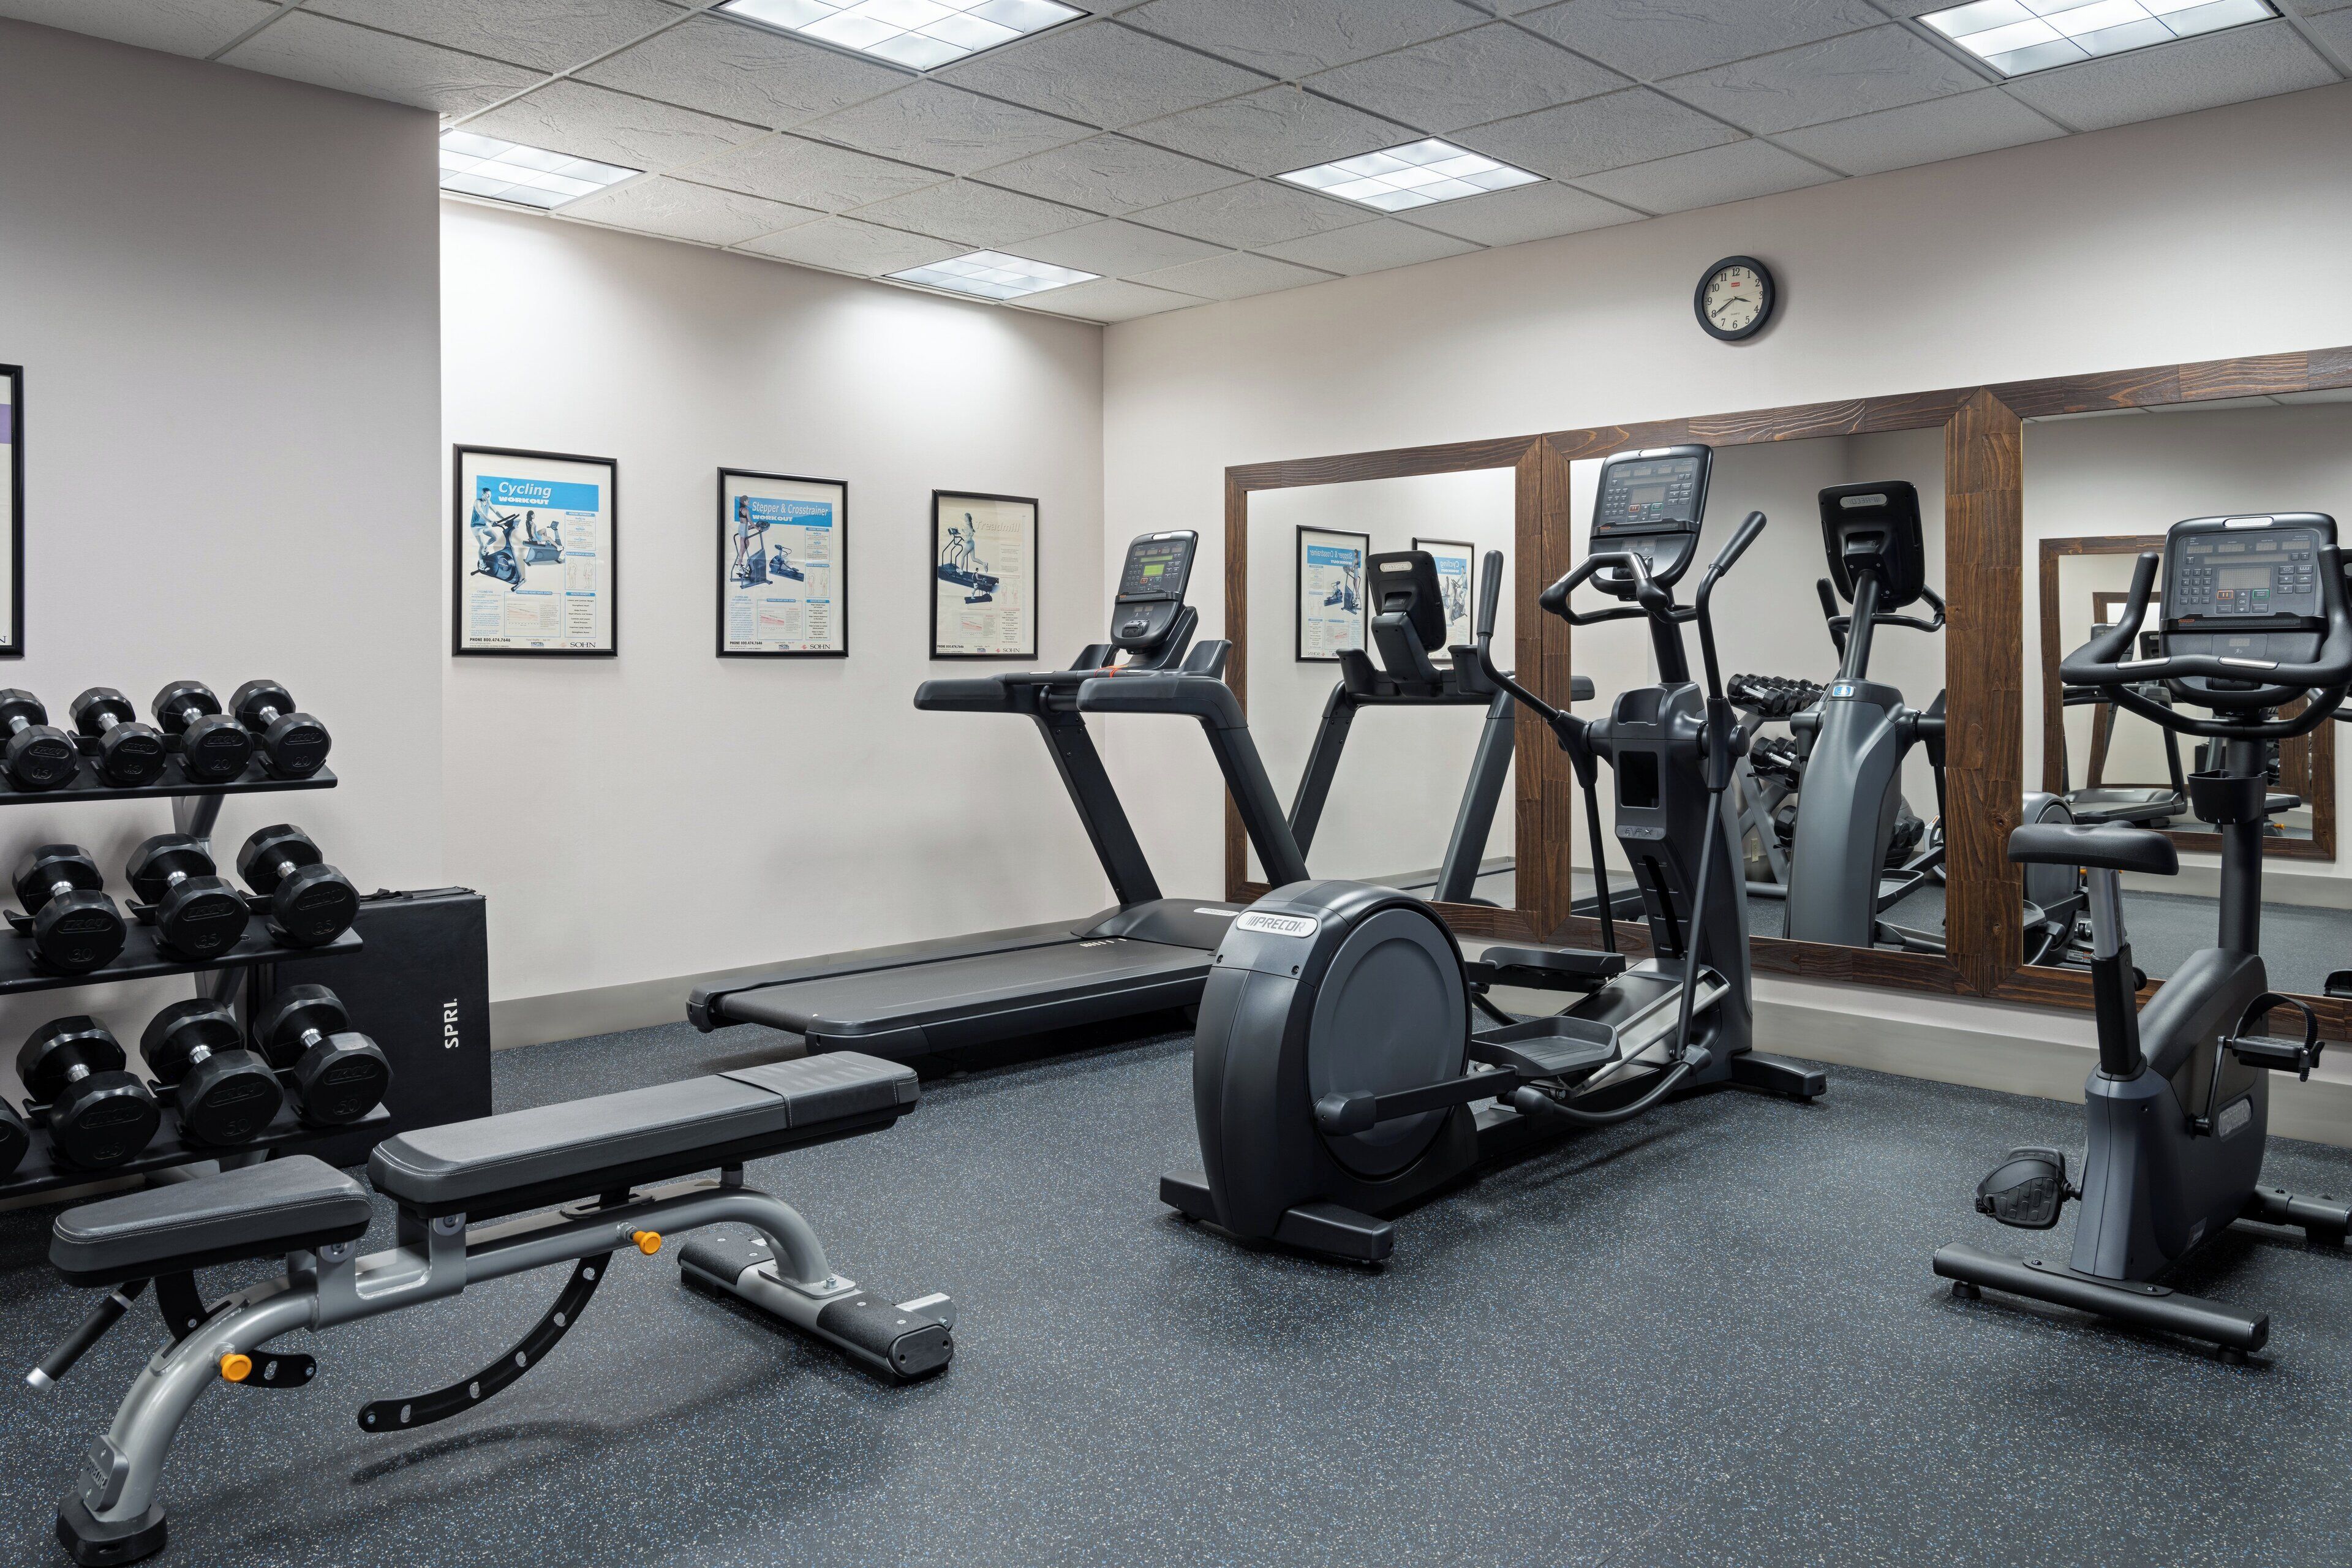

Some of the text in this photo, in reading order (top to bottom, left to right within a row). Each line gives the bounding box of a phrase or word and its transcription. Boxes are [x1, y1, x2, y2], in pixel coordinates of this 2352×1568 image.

[1732, 268, 1740, 277] 12
[1747, 270, 1751, 279] 1
[1721, 273, 1727, 282] 11
[1755, 278, 1760, 287] 2
[1711, 283, 1720, 292] 10
[1758, 292, 1763, 300] 3
[1707, 297, 1713, 306] 9
[1711, 310, 1716, 318] 8
[1754, 305, 1760, 314] 4
[1721, 318, 1726, 327] 7
[1732, 320, 1738, 329] 6
[1745, 316, 1750, 325] 5
[499, 481, 552, 499] Cycling
[498, 496, 549, 505] WORKOUT
[752, 502, 829, 516] Stepper & Crosstrainer
[976, 521, 1020, 532] Treadmill
[213, 759, 229, 769] 20
[294, 756, 309, 766] 20
[35, 769, 49, 778] 15
[1252, 916, 1306, 932] PRECOR
[198, 933, 217, 947] 35
[71, 949, 92, 960] 30
[337, 1098, 359, 1114] 50
